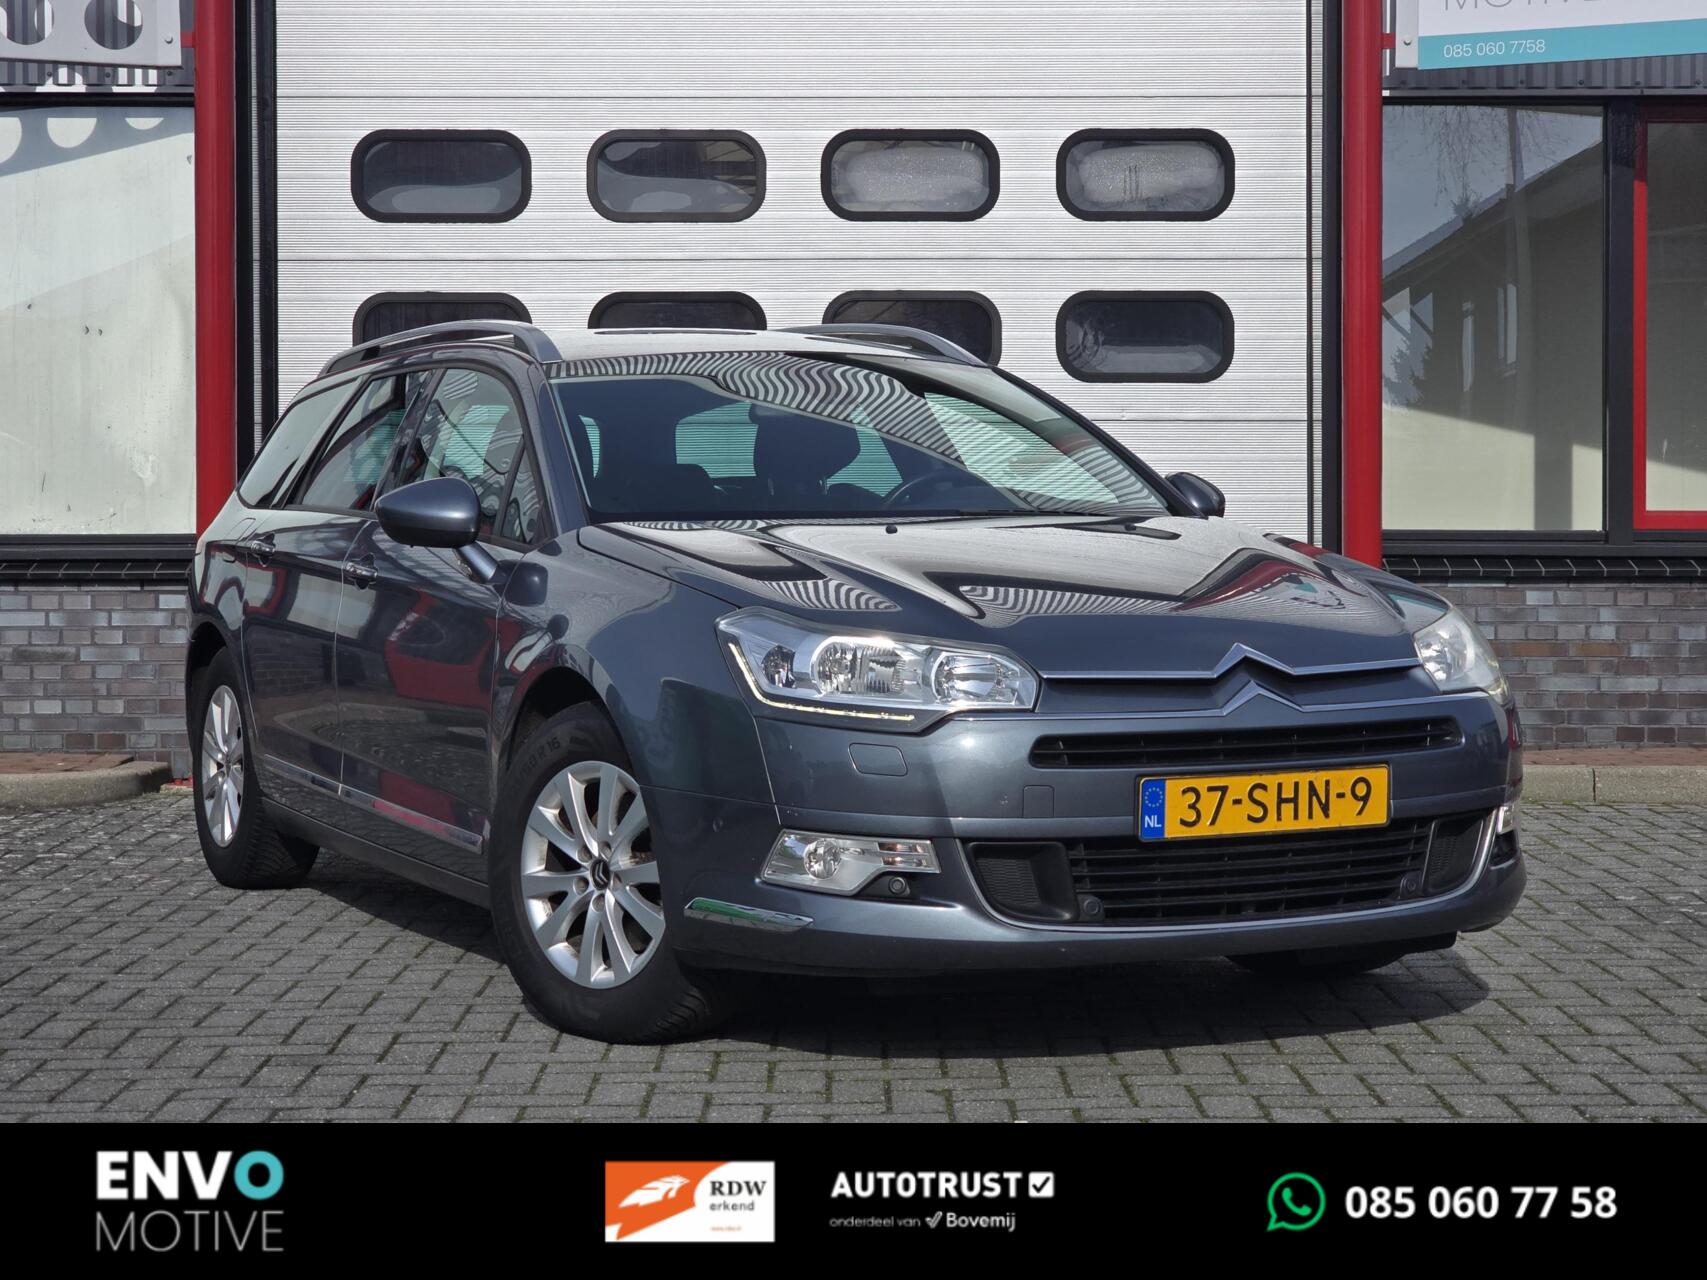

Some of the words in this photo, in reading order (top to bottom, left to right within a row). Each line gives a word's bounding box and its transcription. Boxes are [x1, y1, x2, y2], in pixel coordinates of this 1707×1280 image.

[1443, 43, 1473, 58] 085
[1476, 41, 1506, 56] 060
[1509, 39, 1546, 54] 7758
[546, 735, 561, 753] 16
[1179, 776, 1373, 828] 37-SHN-9
[1144, 815, 1162, 828] NL
